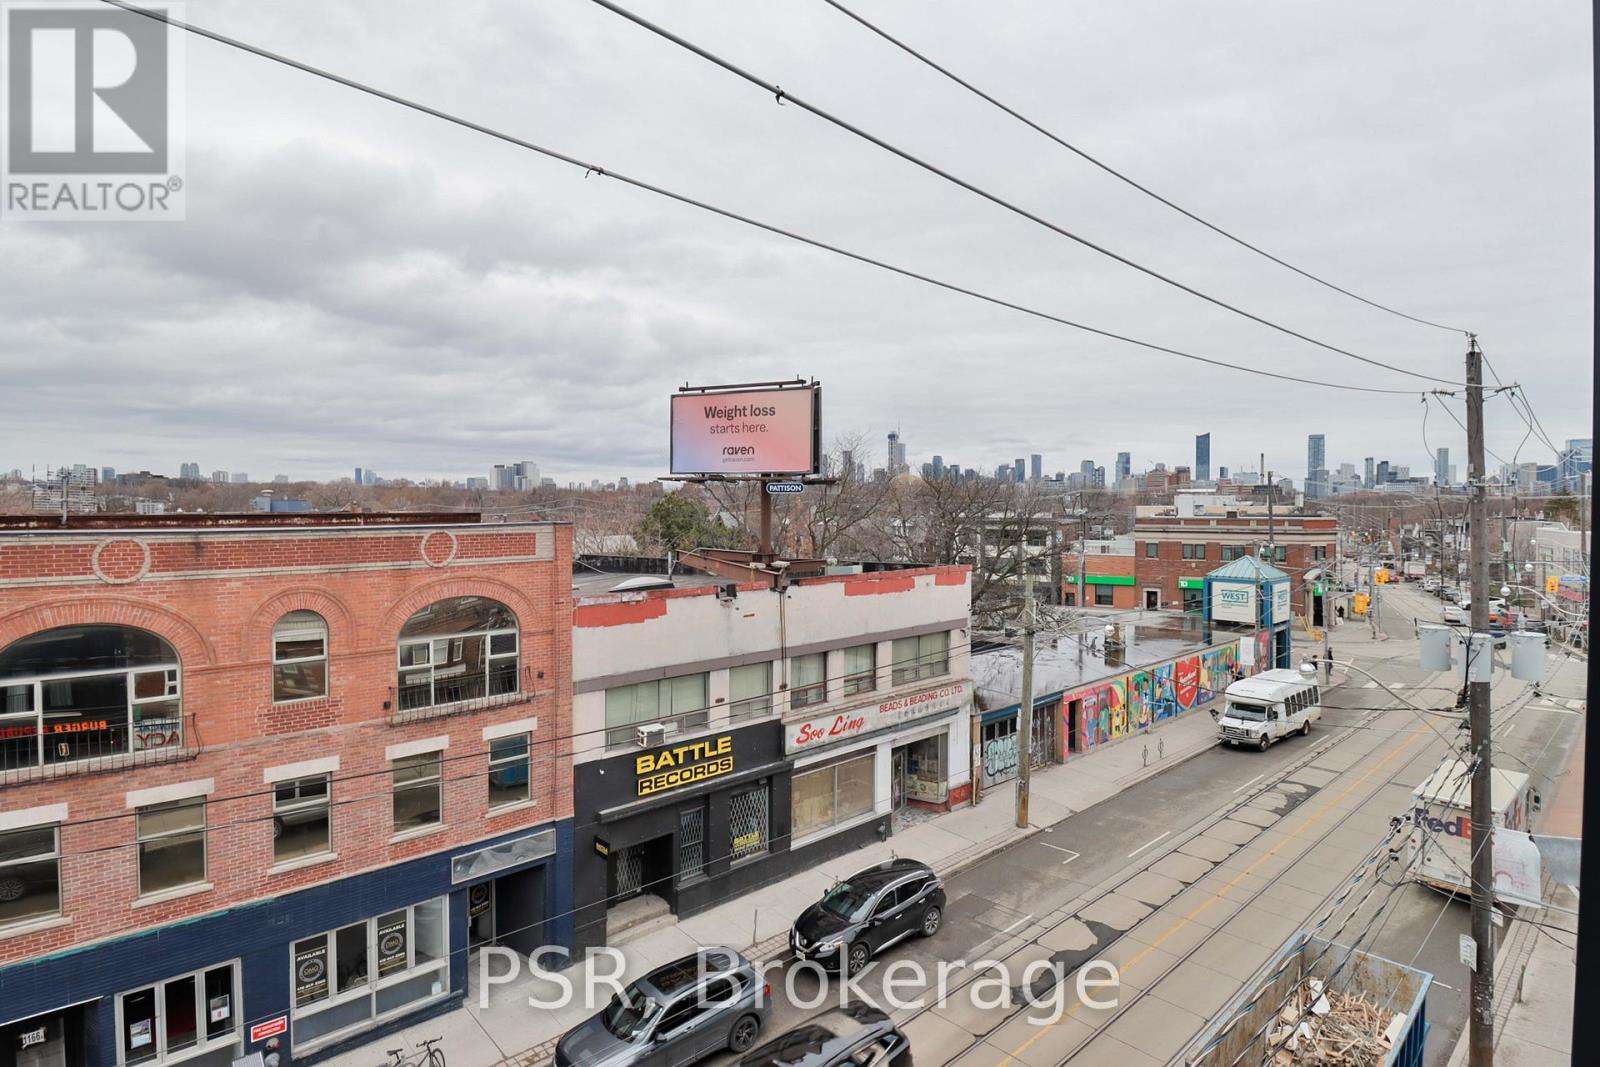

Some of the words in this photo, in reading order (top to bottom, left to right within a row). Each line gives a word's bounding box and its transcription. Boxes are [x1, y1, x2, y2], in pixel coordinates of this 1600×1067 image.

[704, 405, 748, 421] Weight
[750, 404, 776, 417] loss
[710, 423, 740, 434] starts
[742, 422, 769, 433] here.
[722, 446, 755, 456] raven
[768, 484, 802, 492] PATTISON
[1221, 592, 1246, 601] WEST
[879, 701, 903, 713] BEADS
[904, 699, 909, 707] &
[909, 692, 938, 706] BEADING
[940, 688, 950, 697] CO.
[796, 723, 825, 745] Soo
[828, 714, 865, 735] Ling
[636, 736, 732, 775] BATTLE
[638, 757, 733, 795] RECORDS
[1415, 807, 1472, 840] FedE
[296, 949, 327, 962] AVAILABLE
